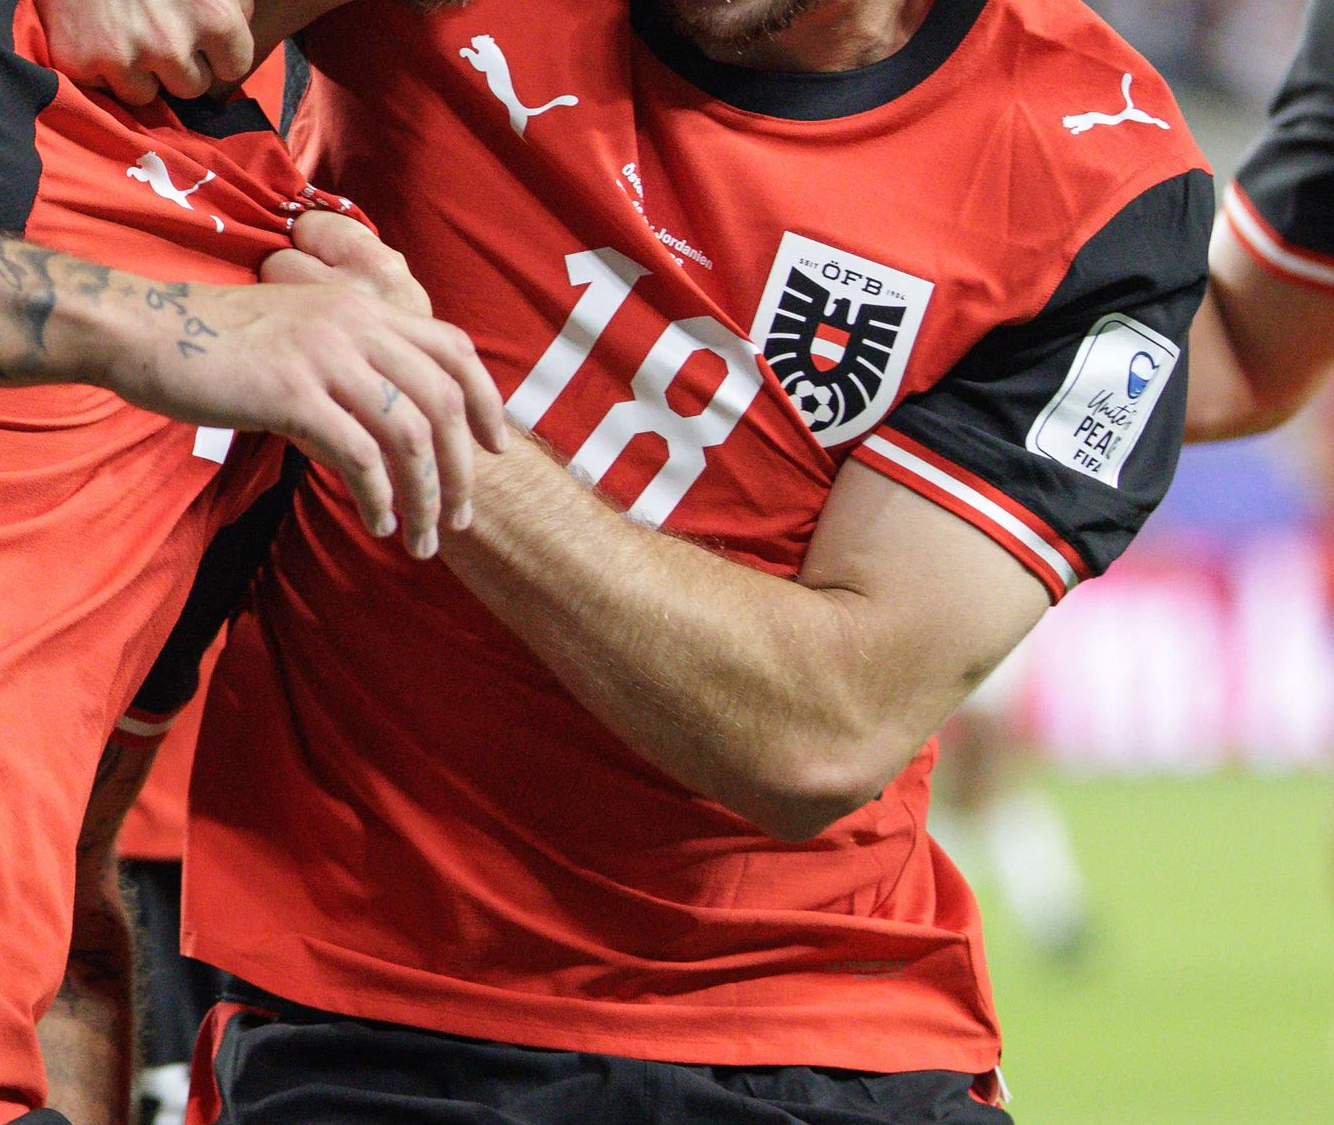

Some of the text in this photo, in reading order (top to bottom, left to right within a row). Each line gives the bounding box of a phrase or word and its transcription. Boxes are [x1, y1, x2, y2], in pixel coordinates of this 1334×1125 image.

[654, 228, 713, 270] Jordanien
[799, 258, 819, 269] SEIT
[822, 260, 883, 296] ÖFB
[503, 247, 764, 531] 18
